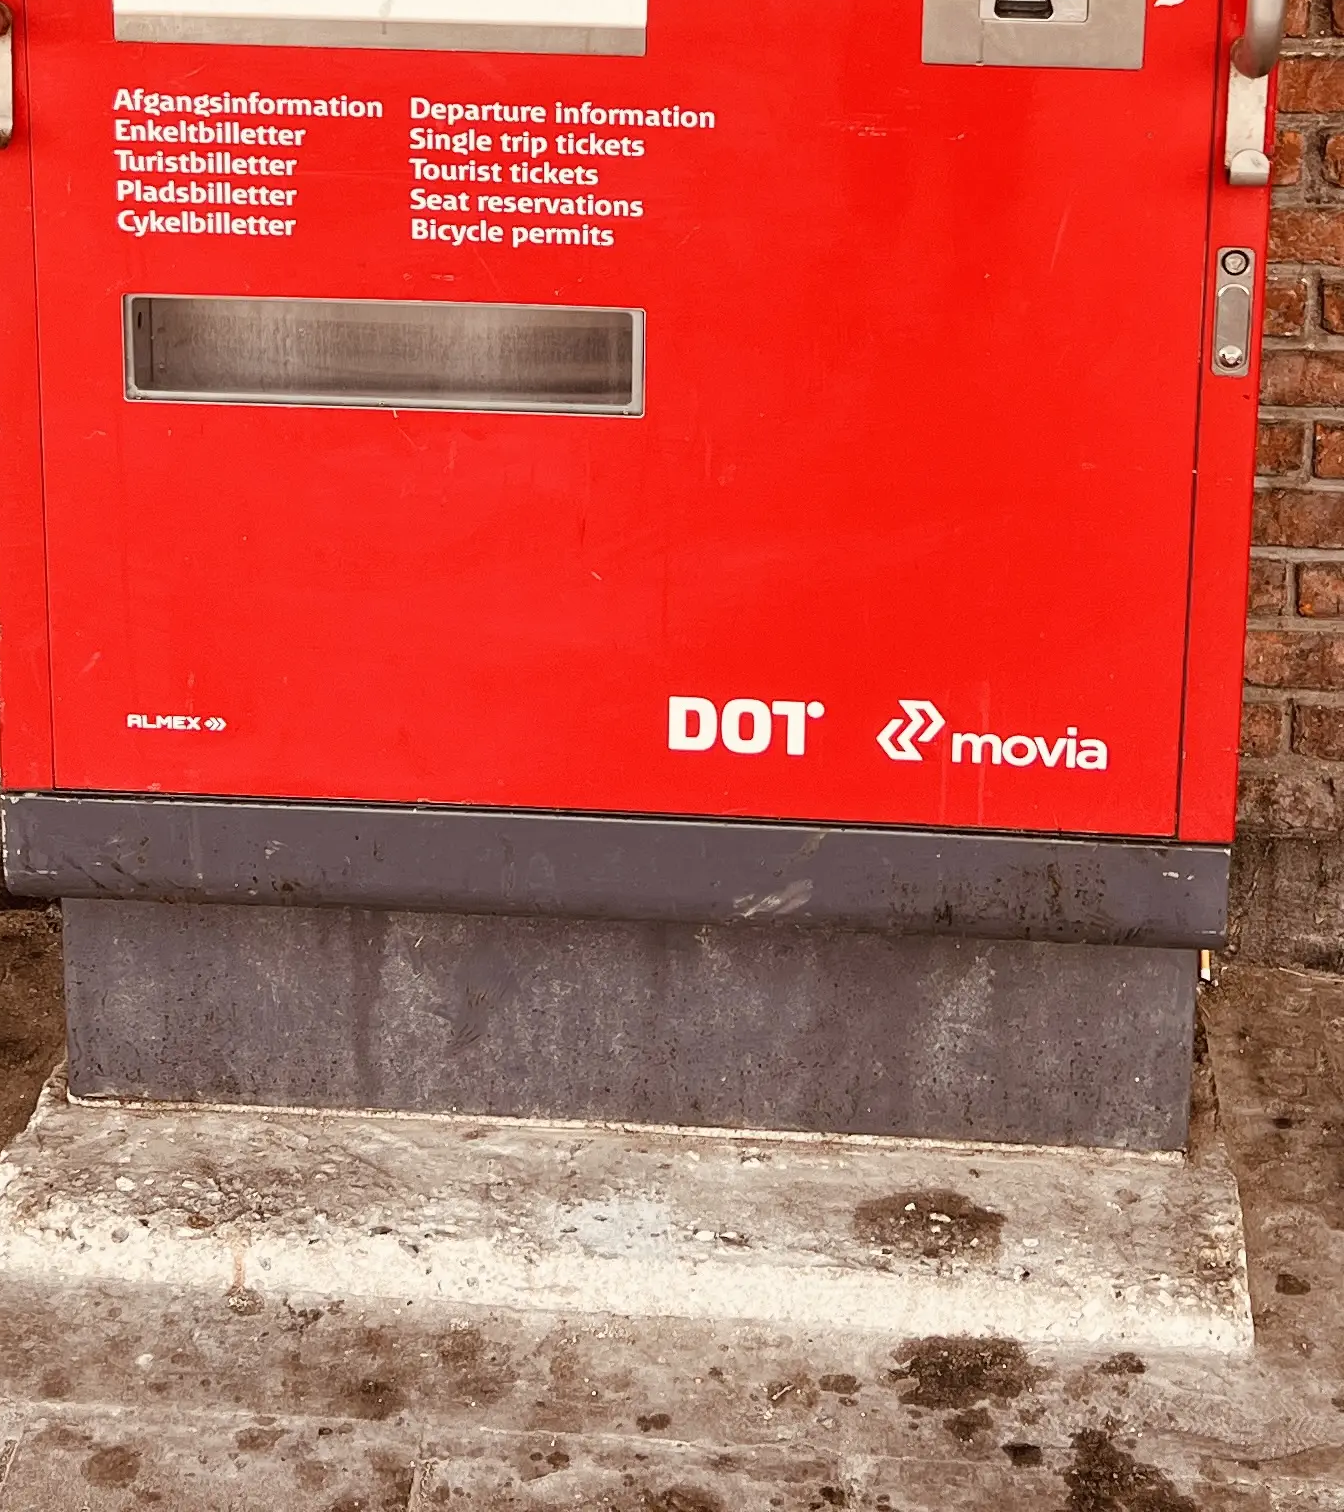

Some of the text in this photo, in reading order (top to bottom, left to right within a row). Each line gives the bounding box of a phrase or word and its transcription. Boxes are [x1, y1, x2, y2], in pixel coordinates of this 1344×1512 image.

[113, 88, 384, 117] Afgangsinformation
[410, 97, 716, 129] Departure information
[114, 119, 306, 146] Enkeltbilletter
[409, 127, 645, 159] Single trip tickets
[113, 149, 298, 176] Turistbilletter
[408, 158, 599, 186] Tourist tickets
[115, 179, 298, 206] Pladsbilletter
[409, 188, 644, 217] Seat reservations
[117, 209, 298, 238] Cykelbilletter
[411, 218, 615, 249] Bicycle permits
[126, 714, 202, 731] ALMEX
[668, 695, 825, 756] DOT
[951, 726, 1108, 770] movia
